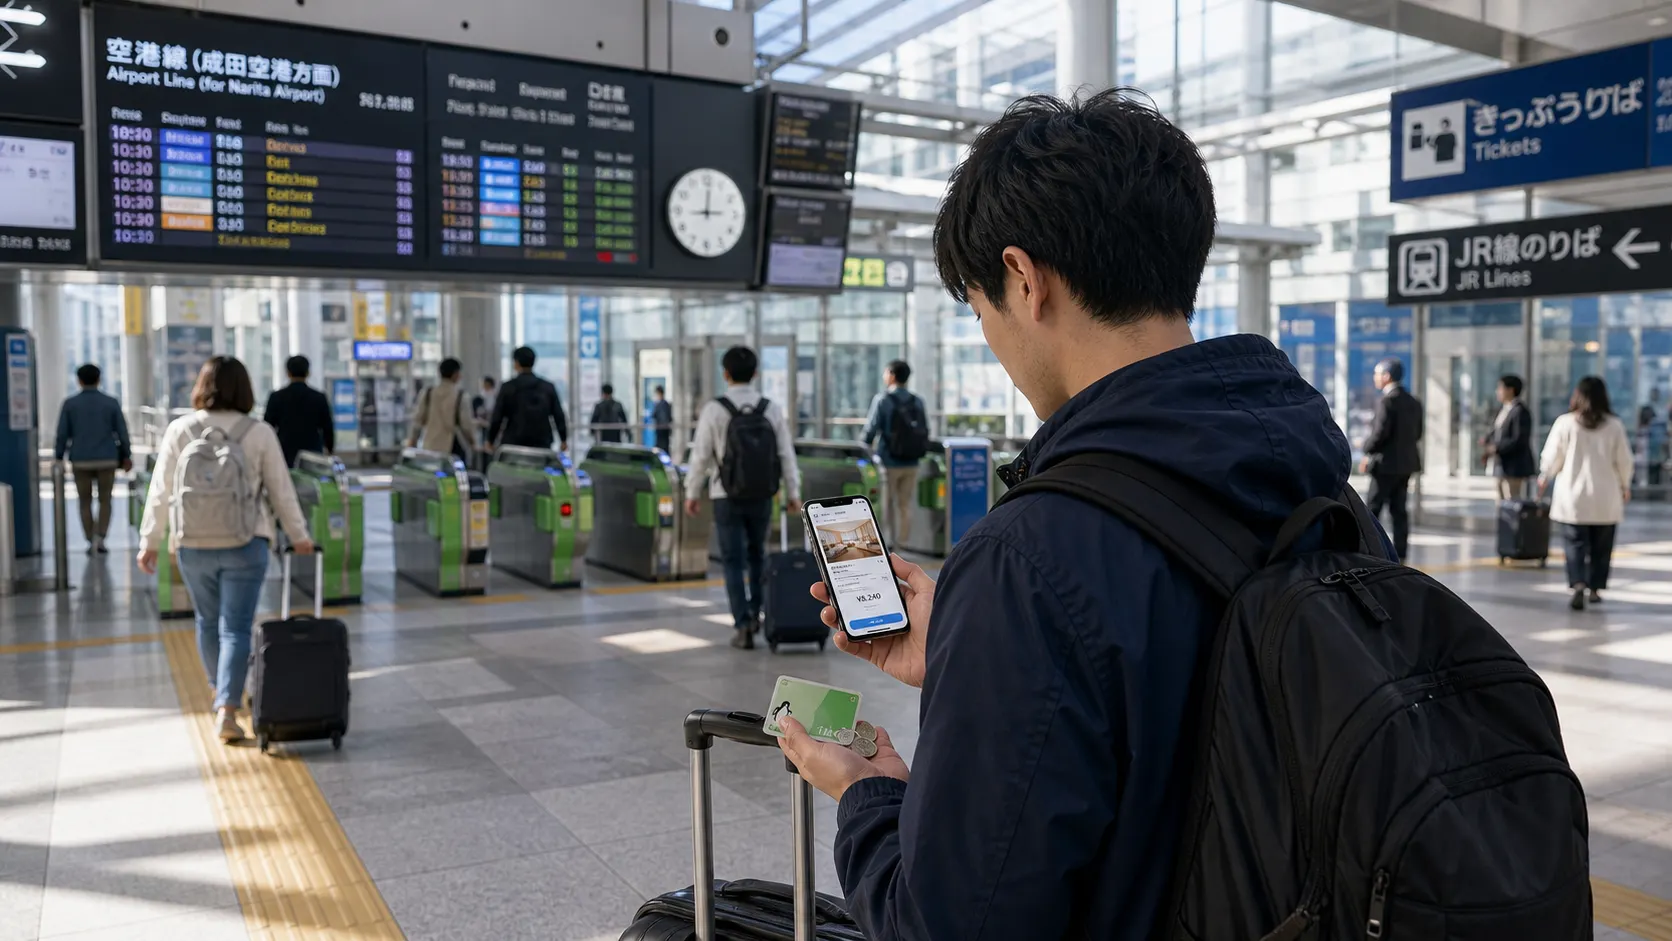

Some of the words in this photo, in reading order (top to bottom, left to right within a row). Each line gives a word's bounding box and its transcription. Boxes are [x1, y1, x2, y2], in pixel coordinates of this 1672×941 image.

[106, 65, 160, 86] Airport
[164, 71, 195, 90] Line
[199, 76, 225, 93] (for
[228, 78, 271, 97] Narita
[273, 84, 326, 105] Airport)
[1472, 137, 1541, 161] Tickets
[1454, 225, 1602, 268] JR線のりば
[1456, 271, 1480, 291] JR
[1484, 267, 1532, 289] Lines
